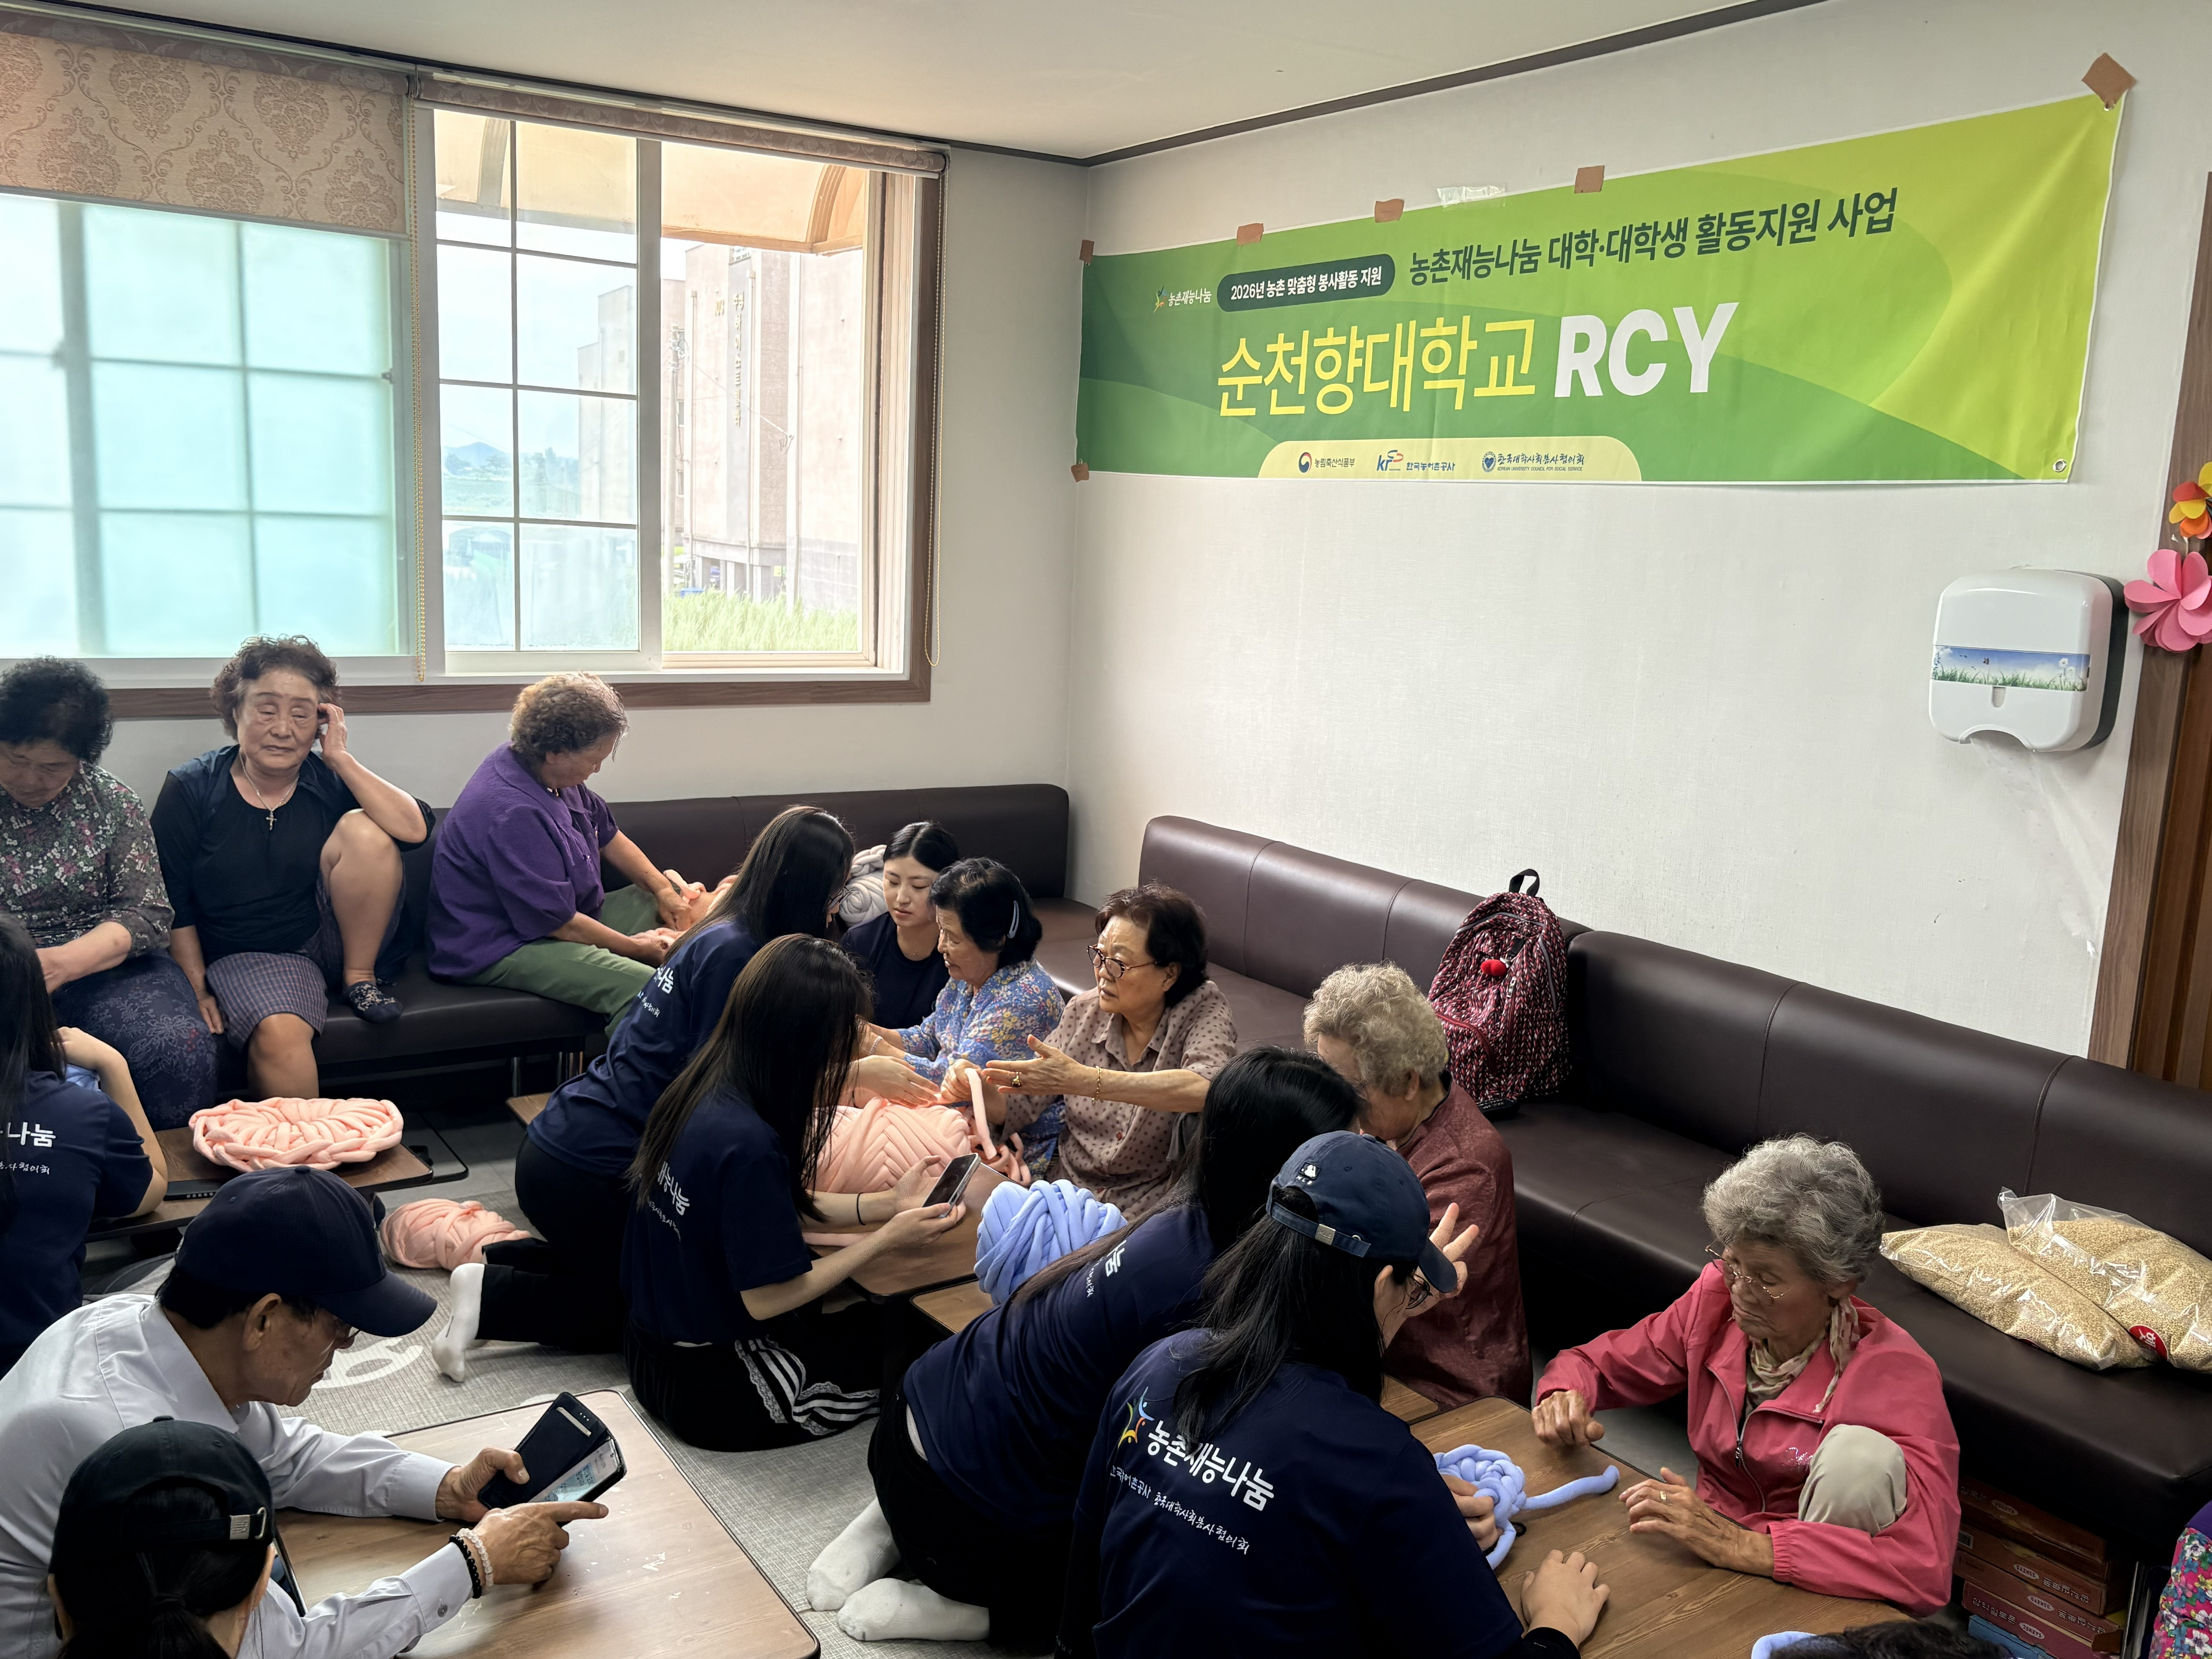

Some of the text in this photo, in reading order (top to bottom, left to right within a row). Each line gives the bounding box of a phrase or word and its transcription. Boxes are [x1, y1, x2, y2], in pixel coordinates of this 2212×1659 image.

[1410, 187, 1899, 286] 농촌재능나눔 대학·대학생 활동지원 사업
[1168, 288, 1212, 307] 농촌재능나눔
[1230, 266, 1382, 300] 2026년 농촌 맞춤형 봉사활동 지원
[1216, 302, 1739, 417] 순천향대학교 RCY
[1314, 458, 1355, 468] 농림축산식품부
[1406, 462, 1456, 471] 한국농어촌공사
[0, 1121, 56, 1147] 나눔
[1147, 1420, 1274, 1511] 농촌재능나눔
